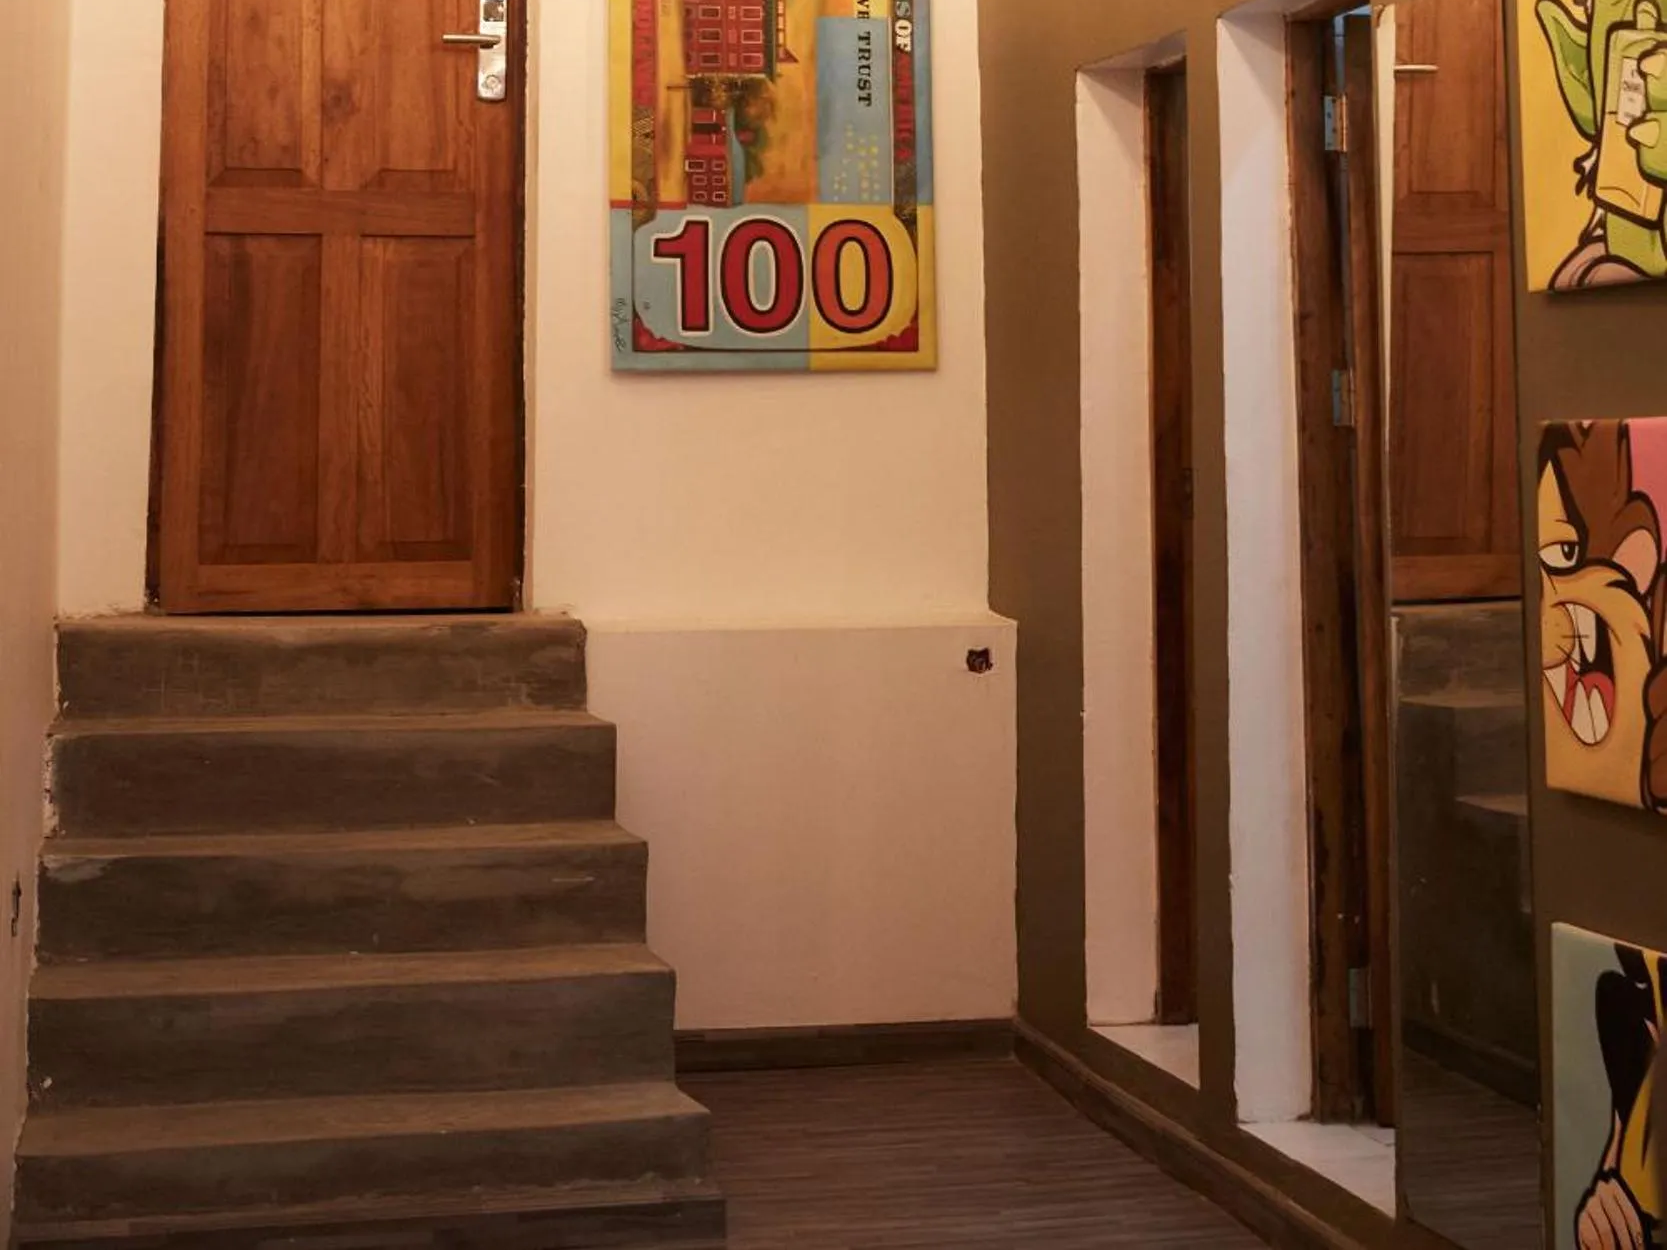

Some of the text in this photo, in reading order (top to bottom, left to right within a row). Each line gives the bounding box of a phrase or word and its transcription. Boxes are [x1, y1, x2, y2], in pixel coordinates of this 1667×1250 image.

[857, 31, 872, 107] TRUST
[894, 19, 912, 52] OF
[652, 217, 894, 335] 100
